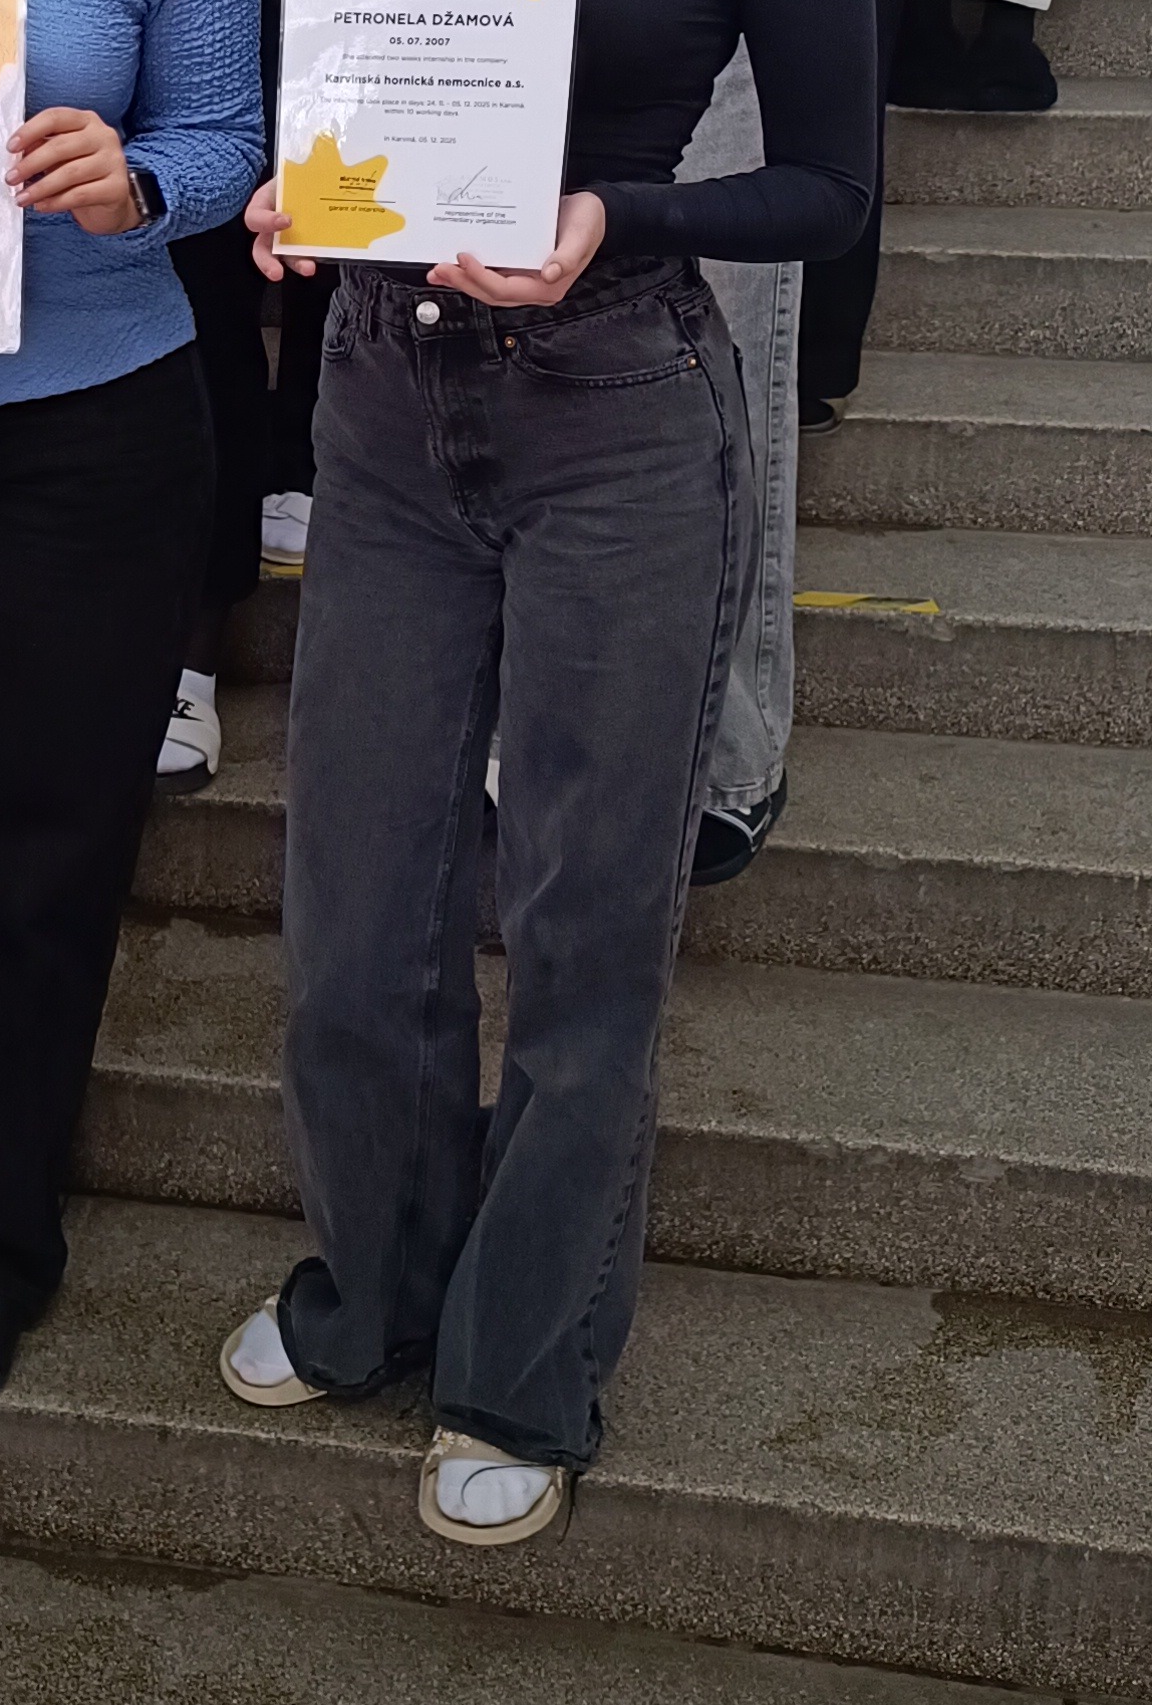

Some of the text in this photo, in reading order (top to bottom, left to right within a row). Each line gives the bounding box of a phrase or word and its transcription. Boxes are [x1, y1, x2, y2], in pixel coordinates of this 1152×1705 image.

[334, 11, 514, 28] PETRONELA DŽAMOVÁ
[390, 37, 450, 46] 05. 07. 2007
[325, 74, 525, 88] Karvinská hornická nemocnice a.s.
